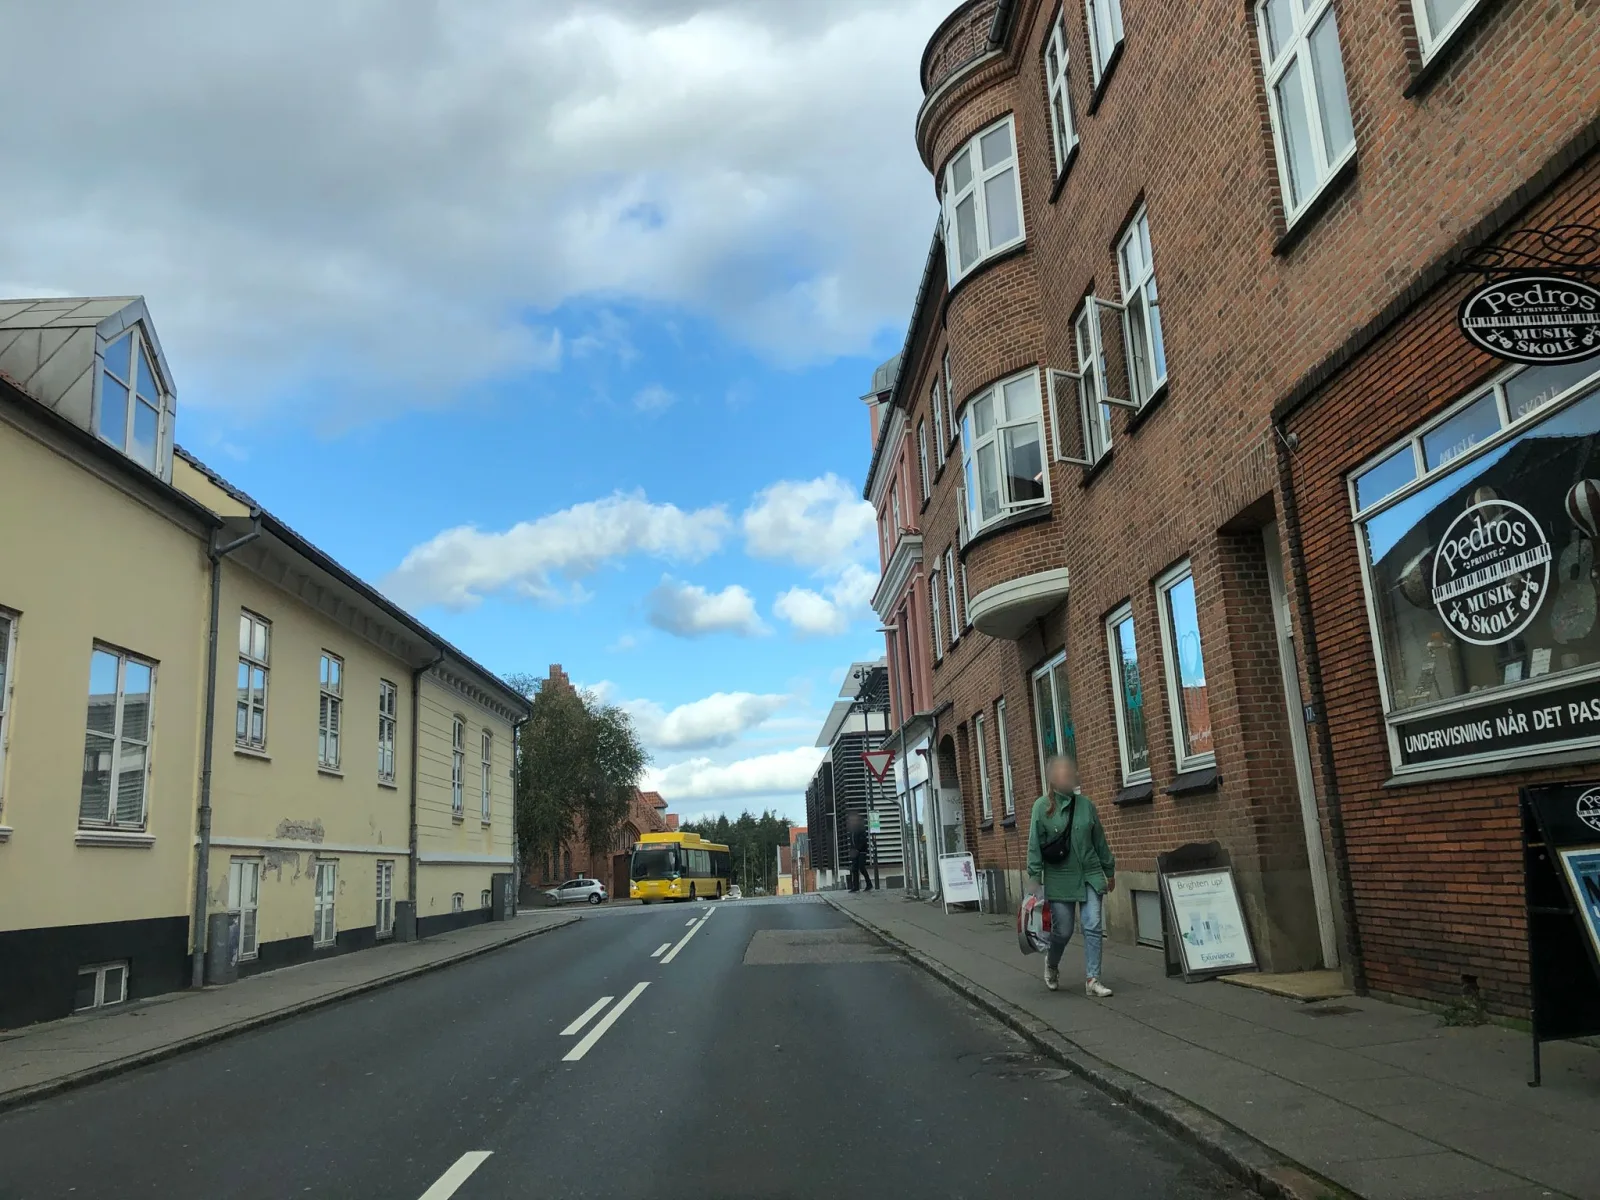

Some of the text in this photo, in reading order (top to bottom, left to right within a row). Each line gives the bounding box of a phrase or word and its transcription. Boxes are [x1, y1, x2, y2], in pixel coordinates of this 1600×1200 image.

[1481, 284, 1596, 314] Pedros
[1512, 327, 1578, 340] MUSIK
[1516, 338, 1579, 354] SKOLE
[1441, 515, 1526, 577] Pedros
[1470, 549, 1498, 567] PRIVATE
[1466, 582, 1516, 615] MUSIK
[1471, 601, 1520, 634] SKOLE
[1405, 720, 1493, 753] UNDERVISNING
[1496, 708, 1529, 737] NÅR
[1532, 705, 1562, 731] DET
[1177, 880, 1209, 890] Brighten
